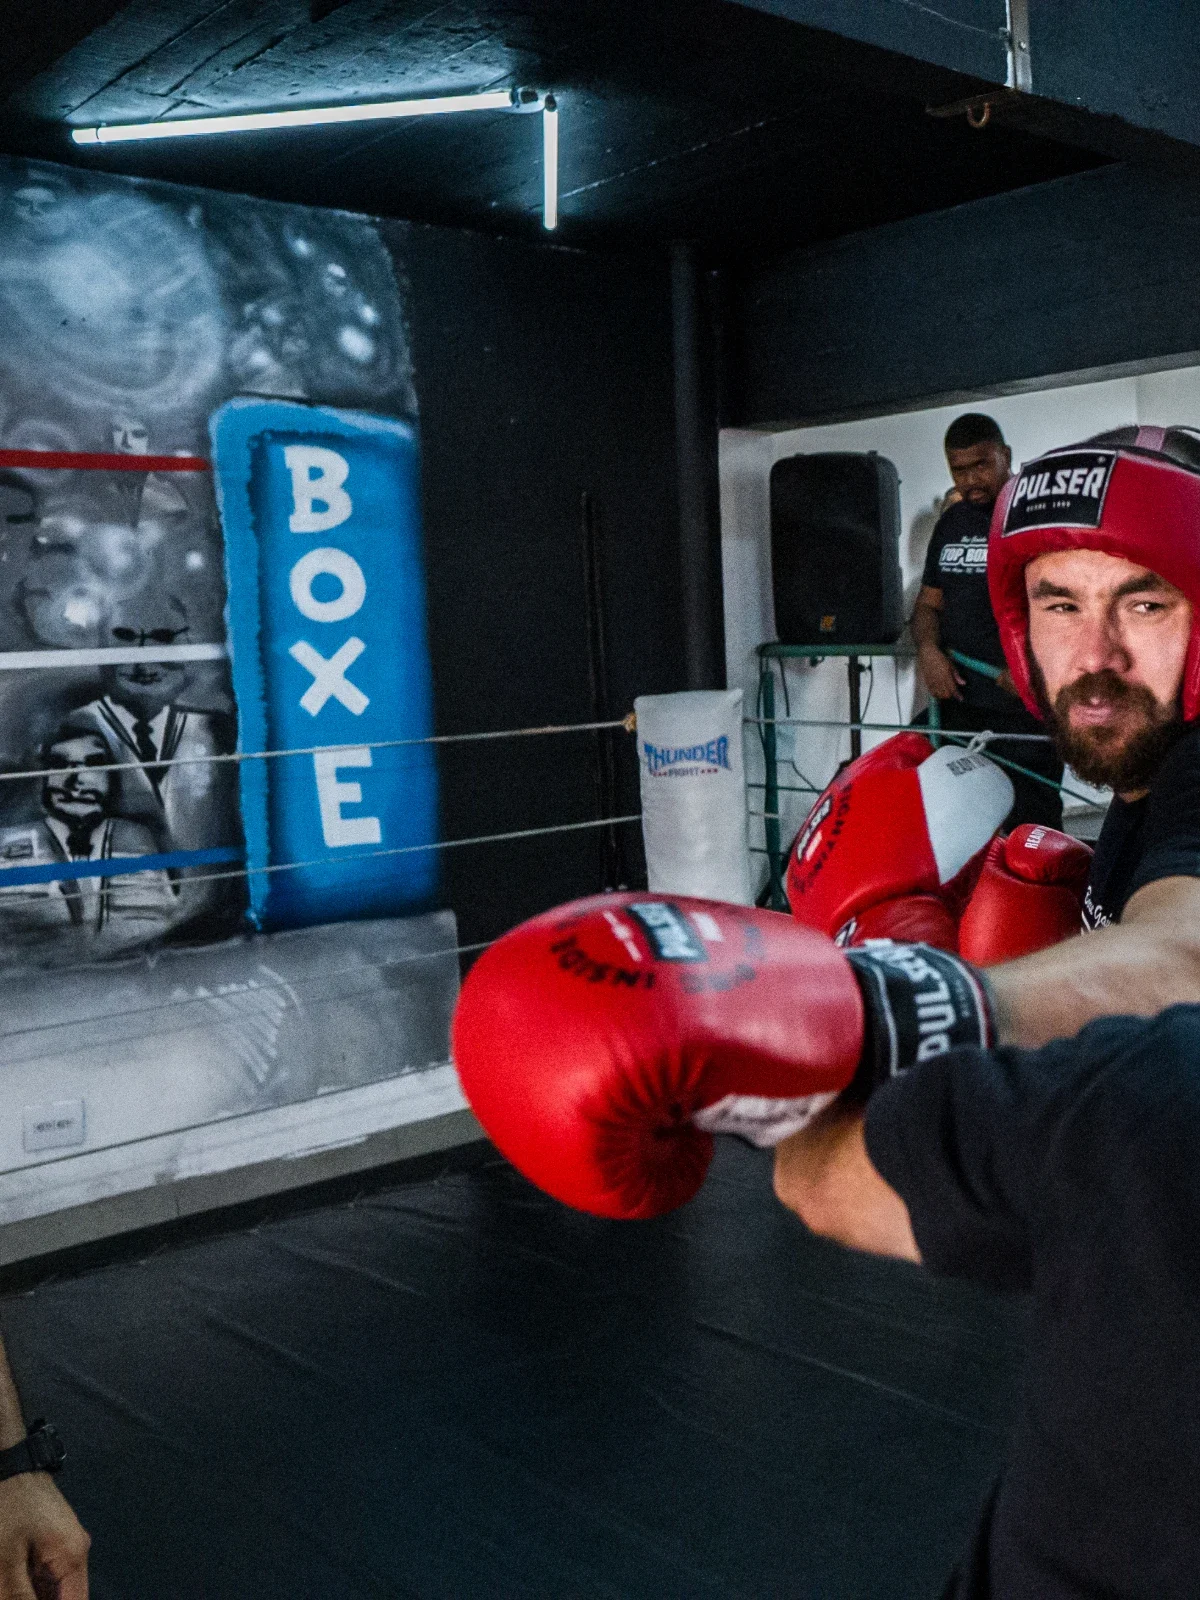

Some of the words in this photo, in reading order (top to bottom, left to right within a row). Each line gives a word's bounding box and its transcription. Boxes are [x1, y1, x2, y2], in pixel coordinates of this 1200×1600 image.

[1012, 466, 1107, 508] PULSER
[284, 445, 382, 849] BOXE
[643, 735, 731, 775] THUNDER
